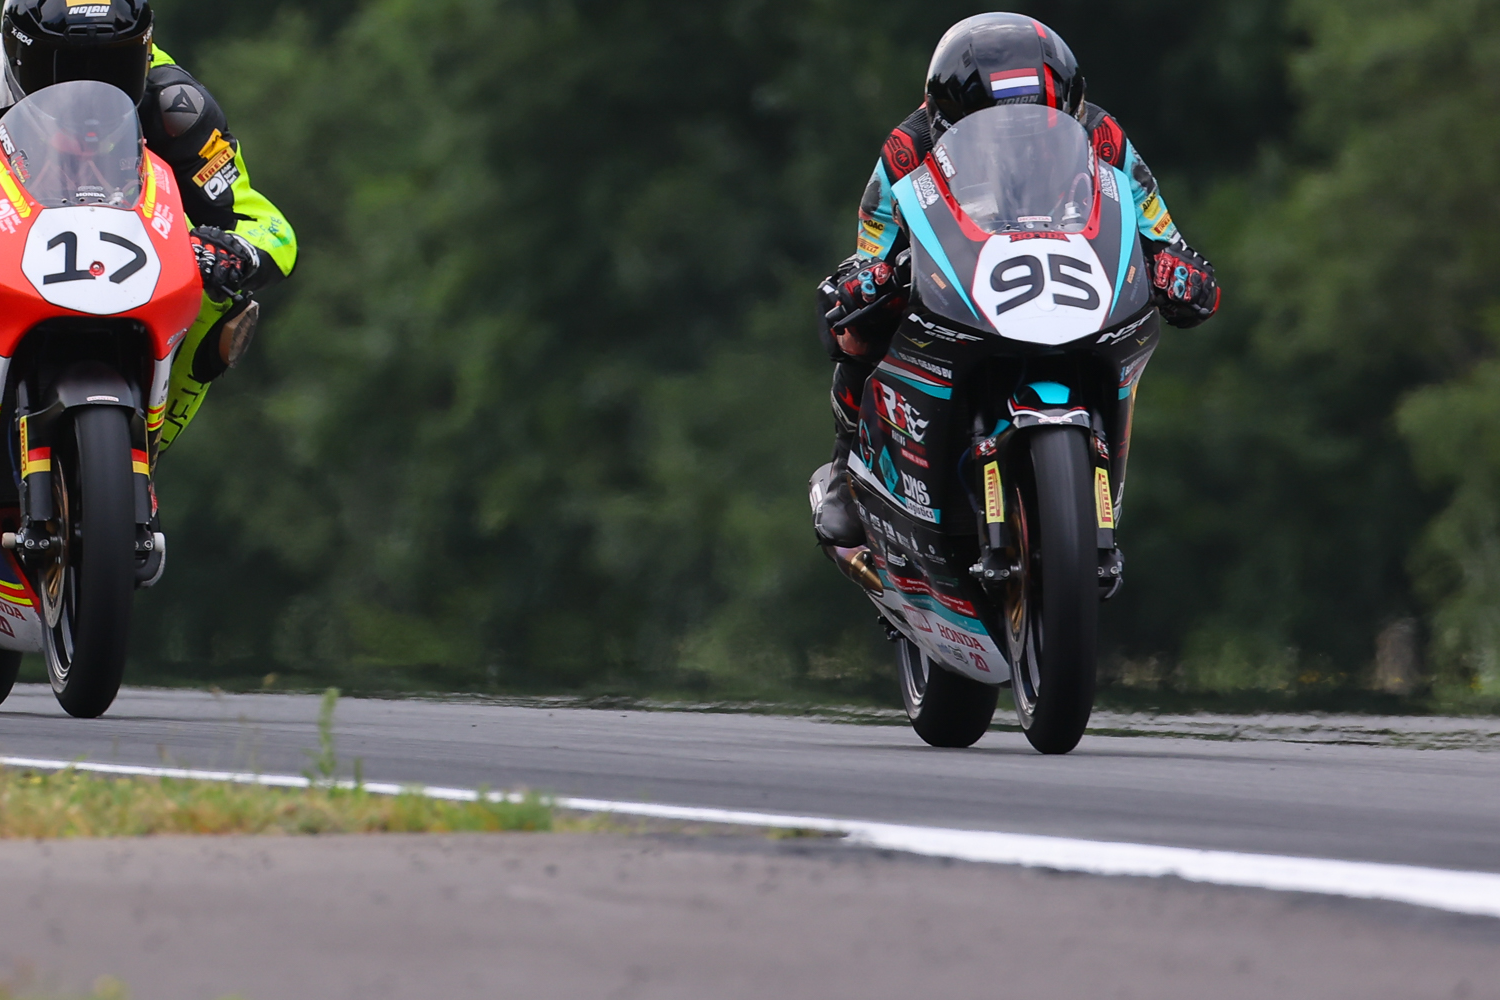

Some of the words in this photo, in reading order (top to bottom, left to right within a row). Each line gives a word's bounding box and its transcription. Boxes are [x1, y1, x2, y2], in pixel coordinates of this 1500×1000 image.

[68, 5, 110, 17] NOLAN
[10, 27, 34, 46] X-804
[197, 149, 231, 182] PIRELLI
[935, 146, 956, 178] WRS
[918, 172, 939, 206] Moto4
[1009, 231, 1071, 243] HONDA
[42, 231, 147, 285] 17
[989, 253, 1100, 316] 95
[907, 313, 984, 342] NSF
[917, 358, 943, 376] GEARS
[941, 367, 952, 379] BV
[987, 468, 1000, 517] PIRELLI
[1098, 473, 1112, 522] PIRELLI
[936, 622, 988, 653] HONDA
